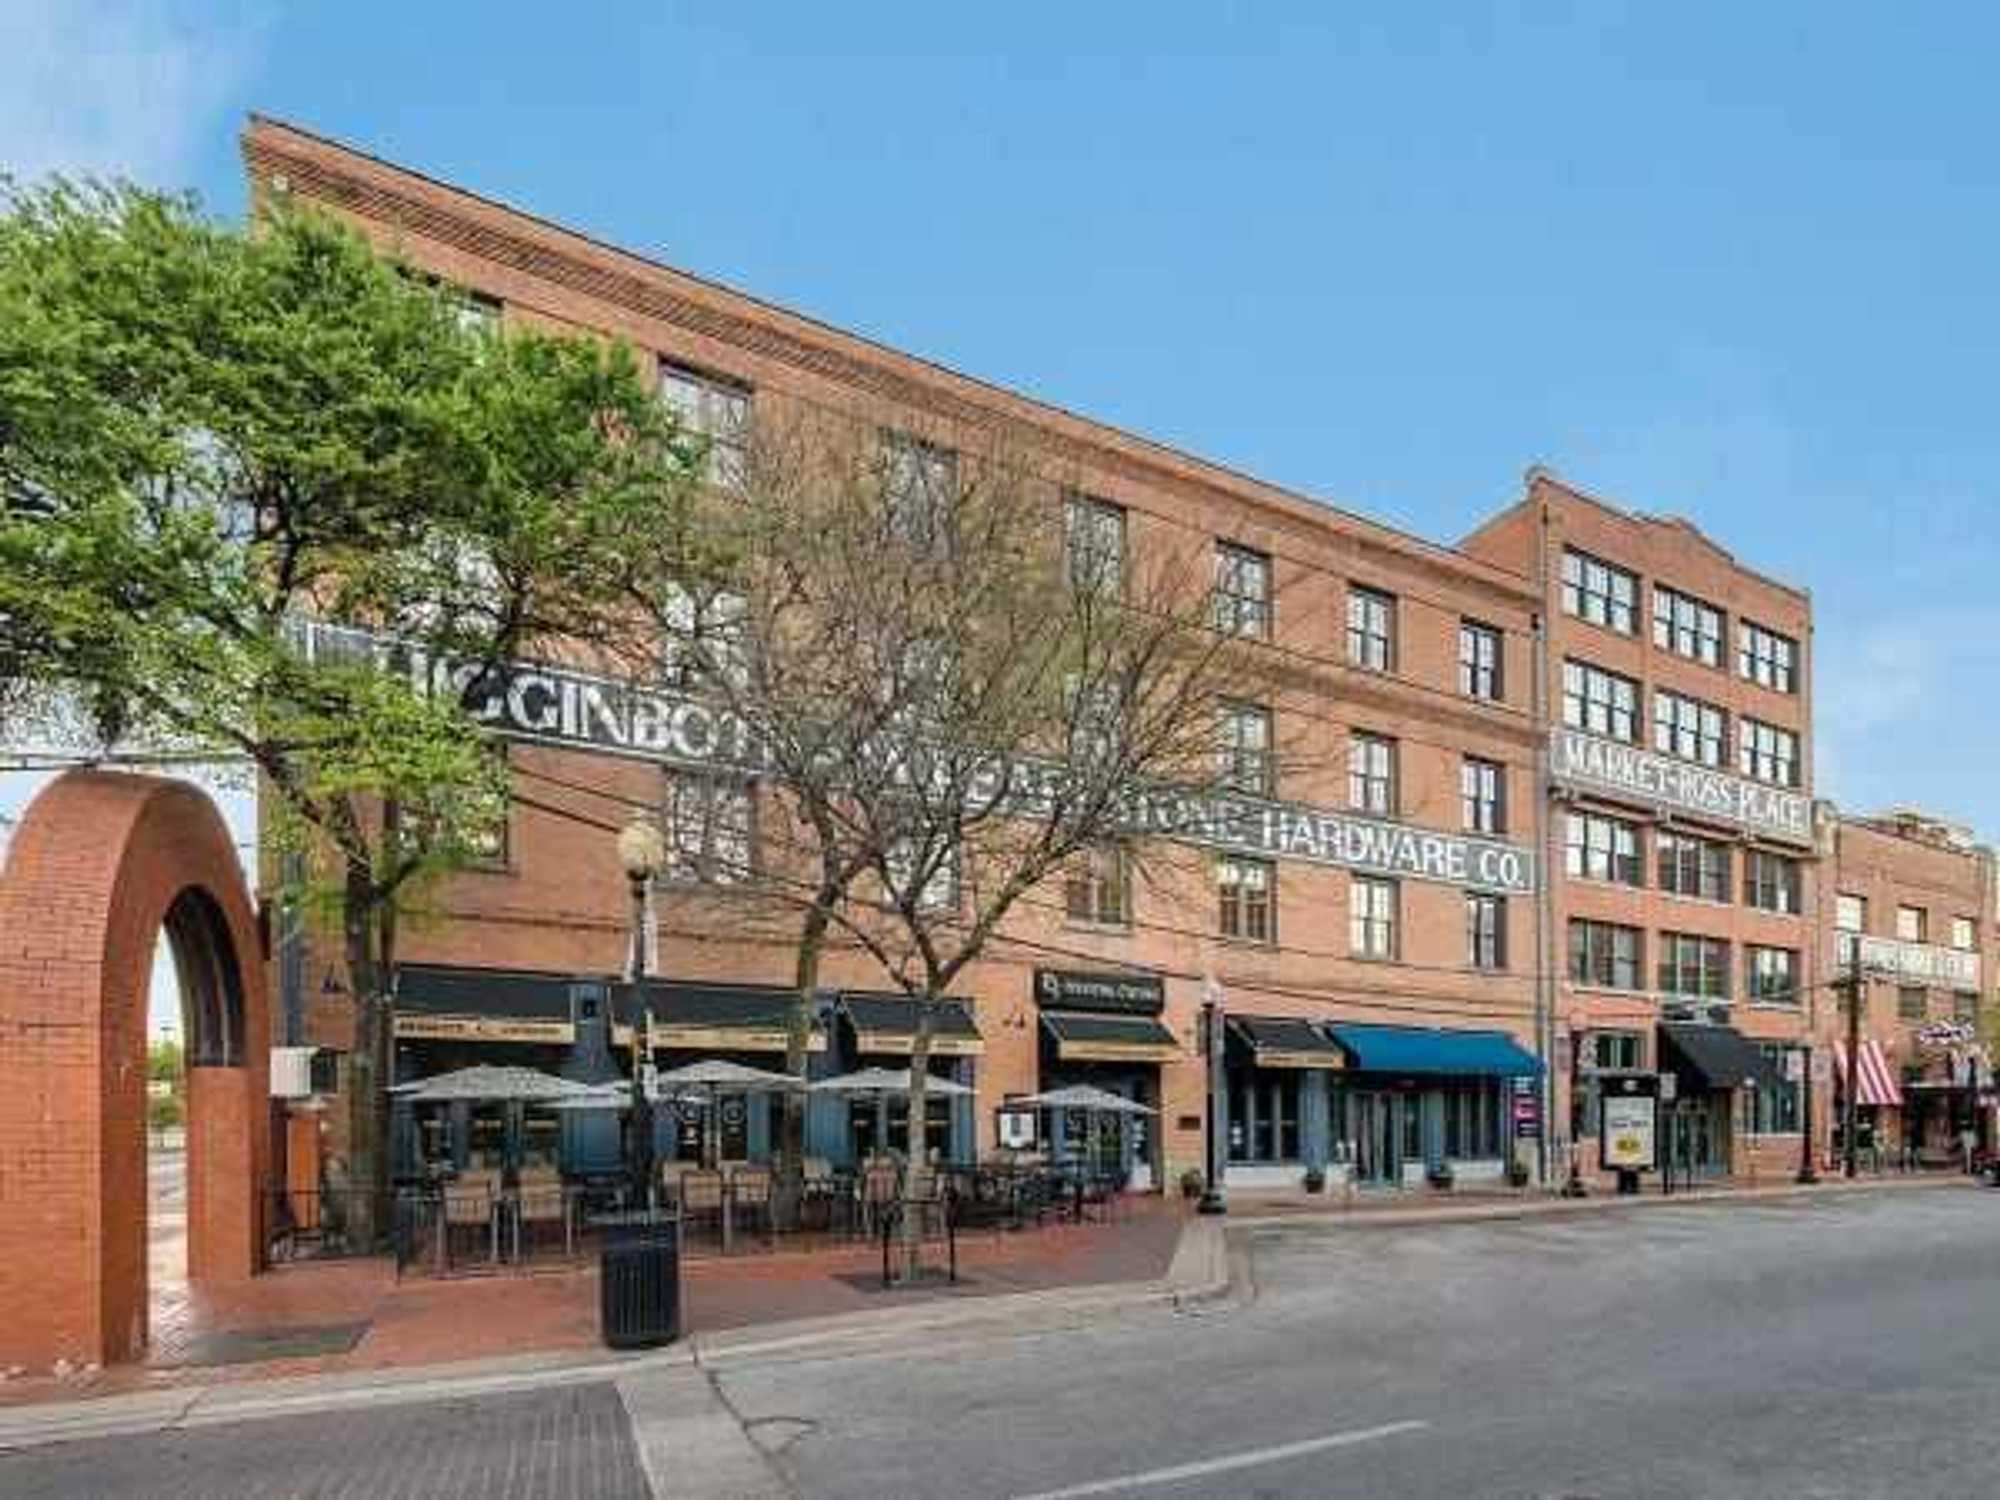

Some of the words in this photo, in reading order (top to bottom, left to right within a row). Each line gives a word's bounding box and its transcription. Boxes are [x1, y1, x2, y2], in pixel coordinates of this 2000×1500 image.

[1739, 784, 1802, 834] PLACE
[1262, 809, 1468, 880] HARDWARE
[1479, 849, 1525, 887] CO.
